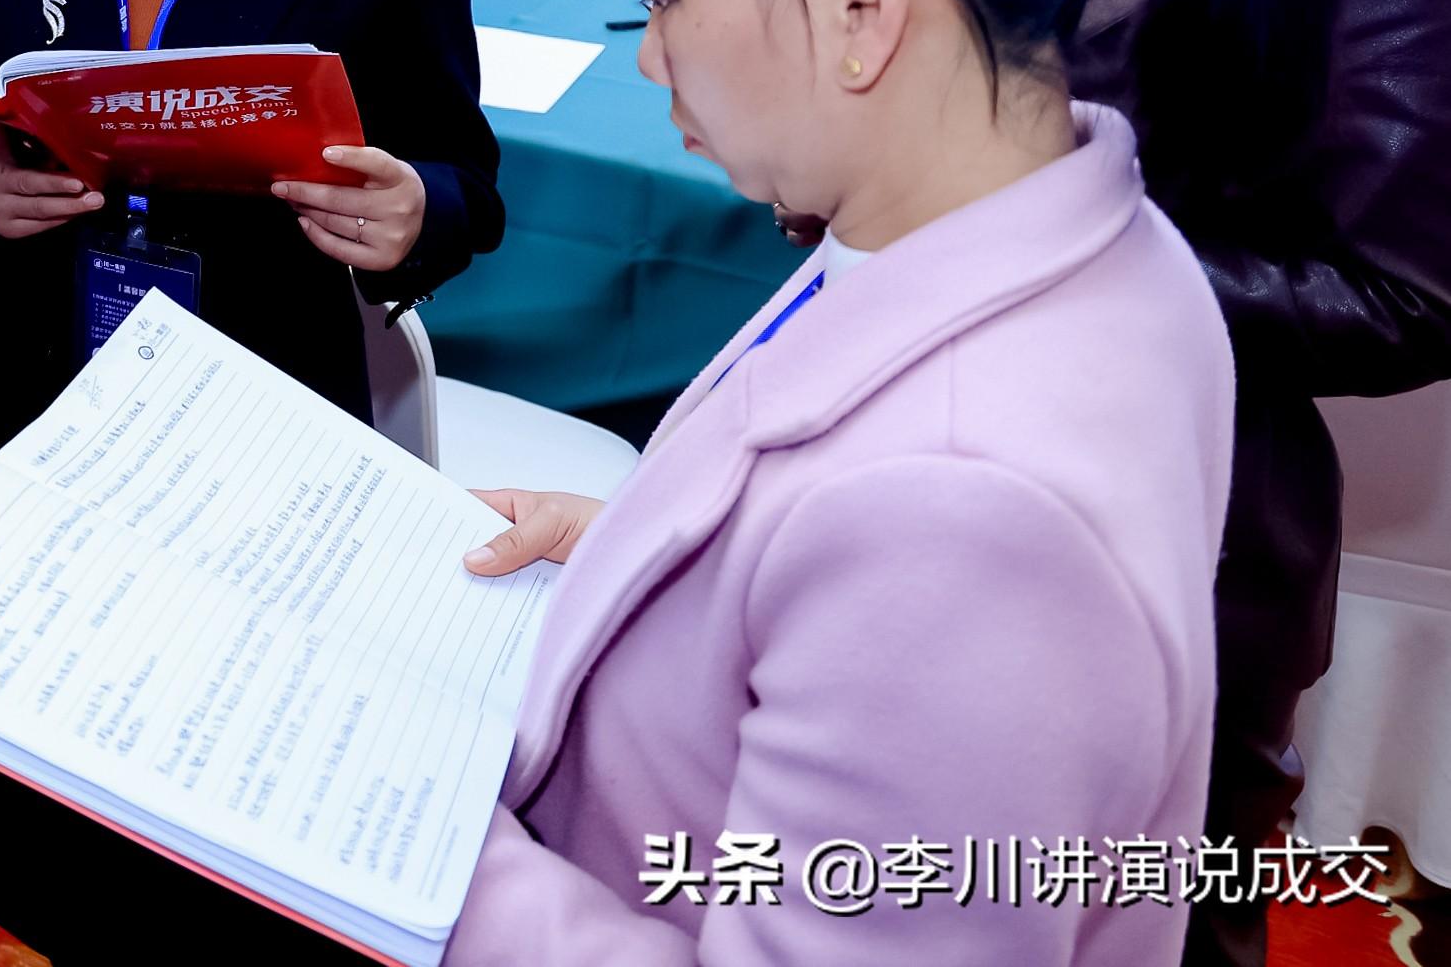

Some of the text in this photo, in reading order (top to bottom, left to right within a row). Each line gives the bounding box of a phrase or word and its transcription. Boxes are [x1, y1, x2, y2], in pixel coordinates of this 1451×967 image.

[89, 85, 293, 121] 演说成交
[250, 99, 294, 109] Done
[100, 108, 298, 131] 成交力就是核心竞争力
